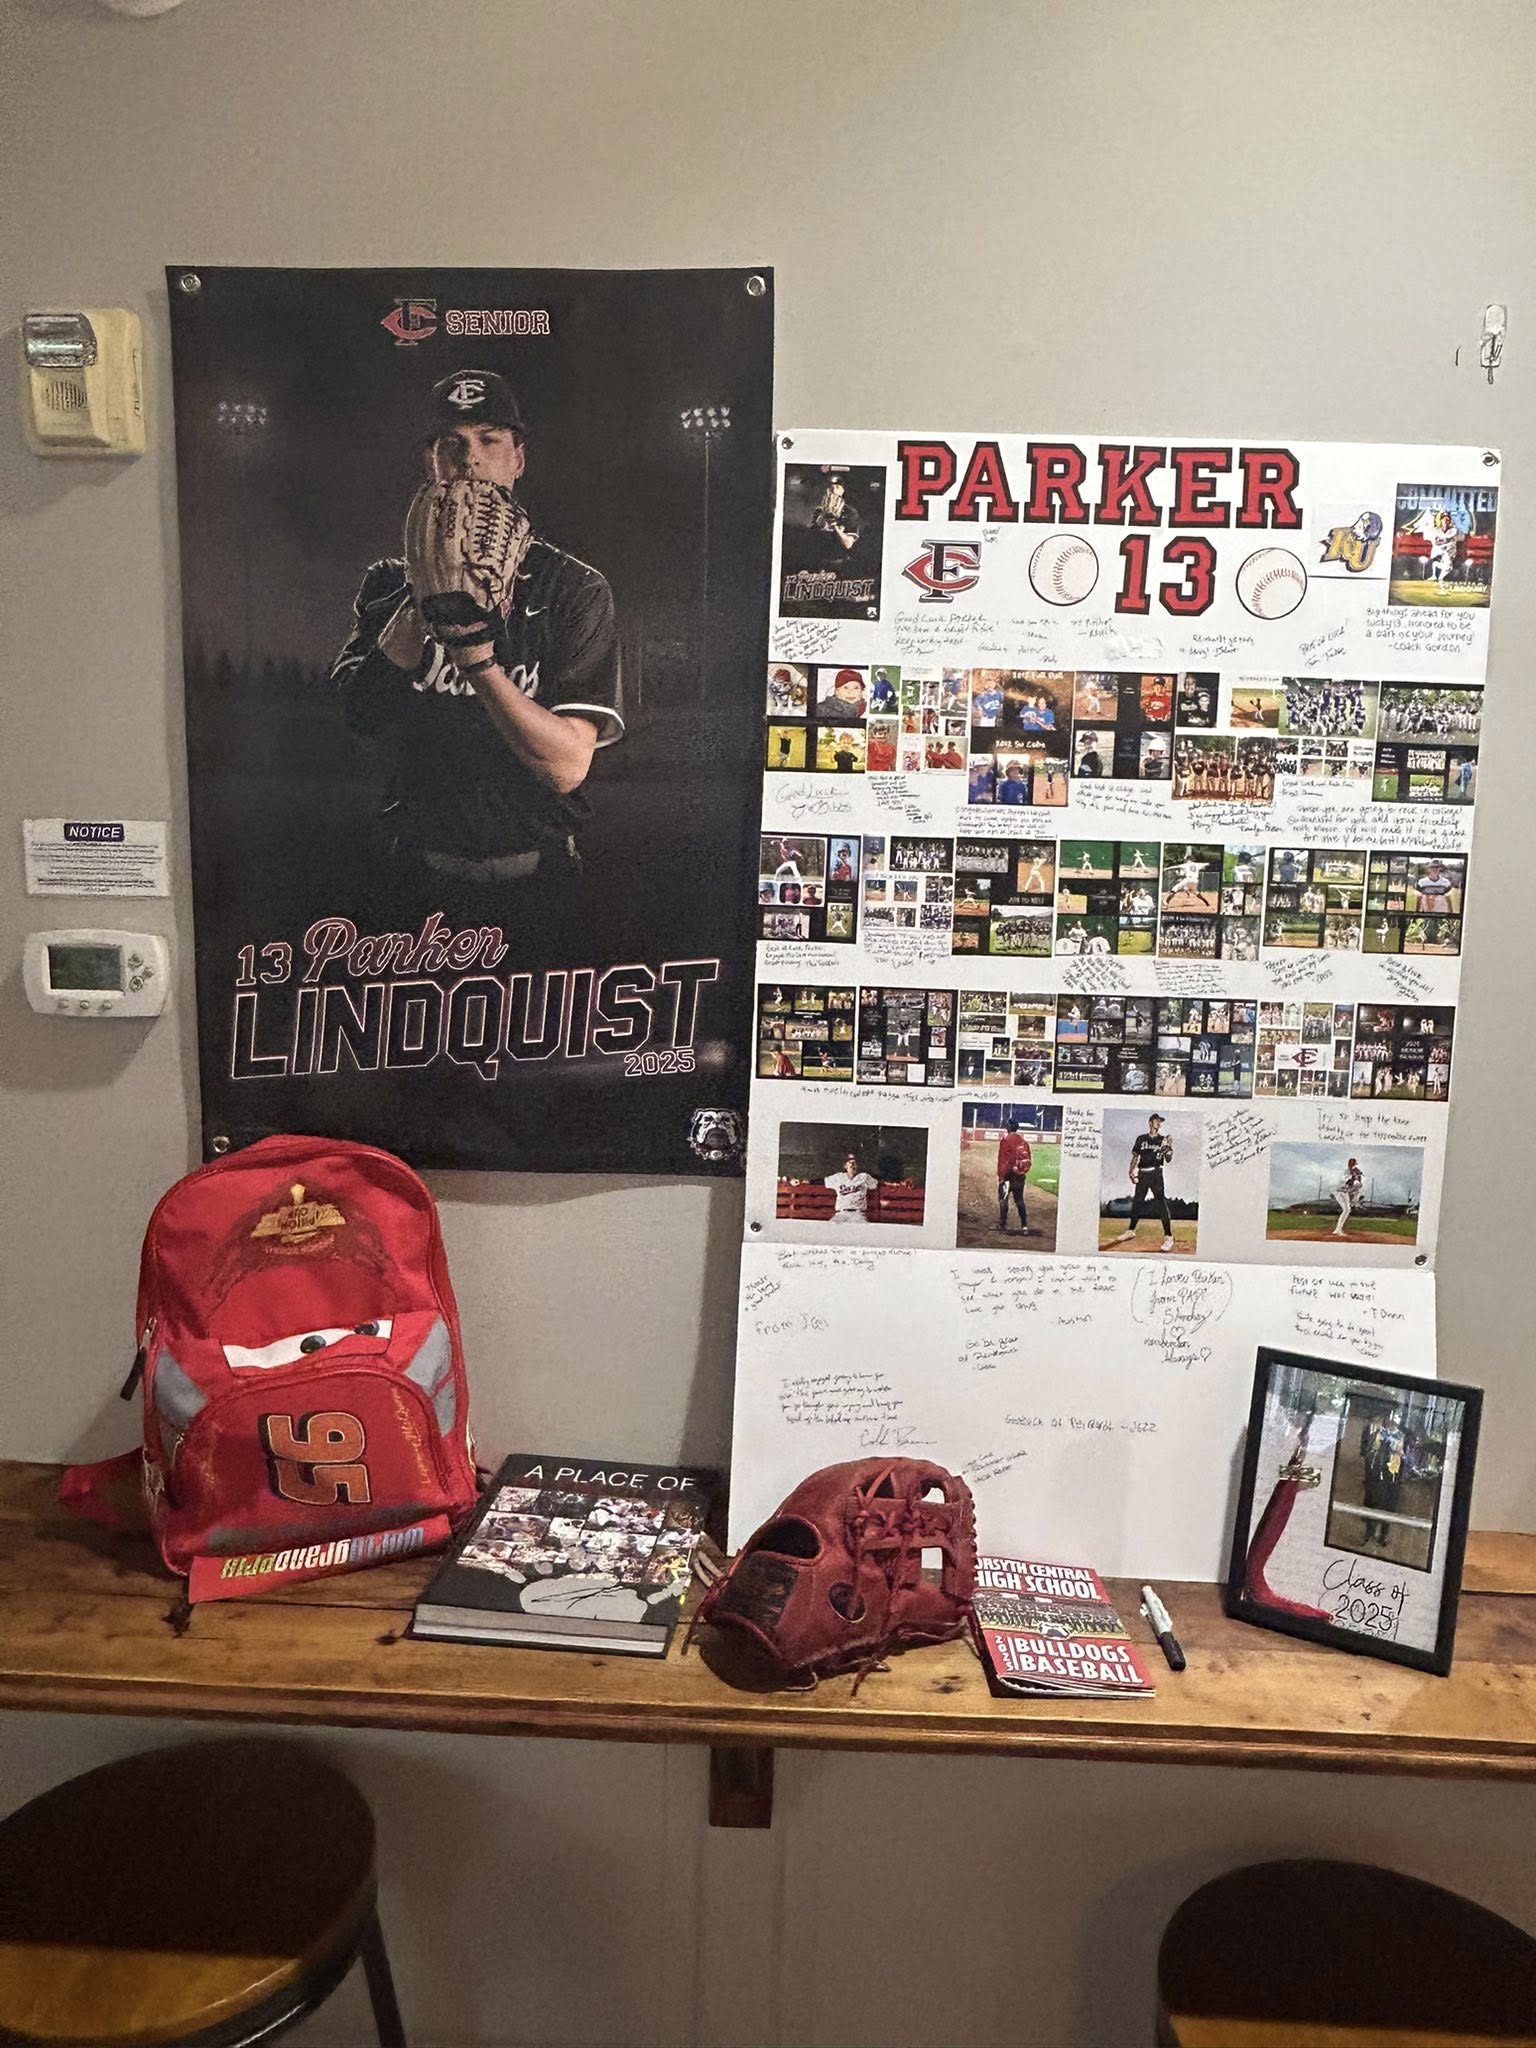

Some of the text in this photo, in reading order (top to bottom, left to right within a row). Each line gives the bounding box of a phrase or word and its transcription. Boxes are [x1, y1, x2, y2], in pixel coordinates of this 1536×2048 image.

[445, 310, 550, 336] SENIOR
[895, 440, 1303, 529] PARKER
[1115, 534, 1216, 616] 13
[69, 826, 121, 839] NOTICE
[236, 911, 509, 986] 13 Parker
[231, 959, 720, 1081] LINDQUIST
[624, 1049, 696, 1077] 2025
[264, 1411, 371, 1505] 95
[524, 1465, 697, 1491] A PLACE OF
[1025, 1576, 1102, 1600] SCHOOL
[1029, 1563, 1094, 1582] CENTRAL
[1323, 1558, 1386, 1598] Class
[1335, 1594, 1394, 1631] 2025
[994, 1635, 1014, 1672] 2025
[1013, 1636, 1132, 1663] BULLDOGS
[1018, 1653, 1144, 1684] BASEBALL
